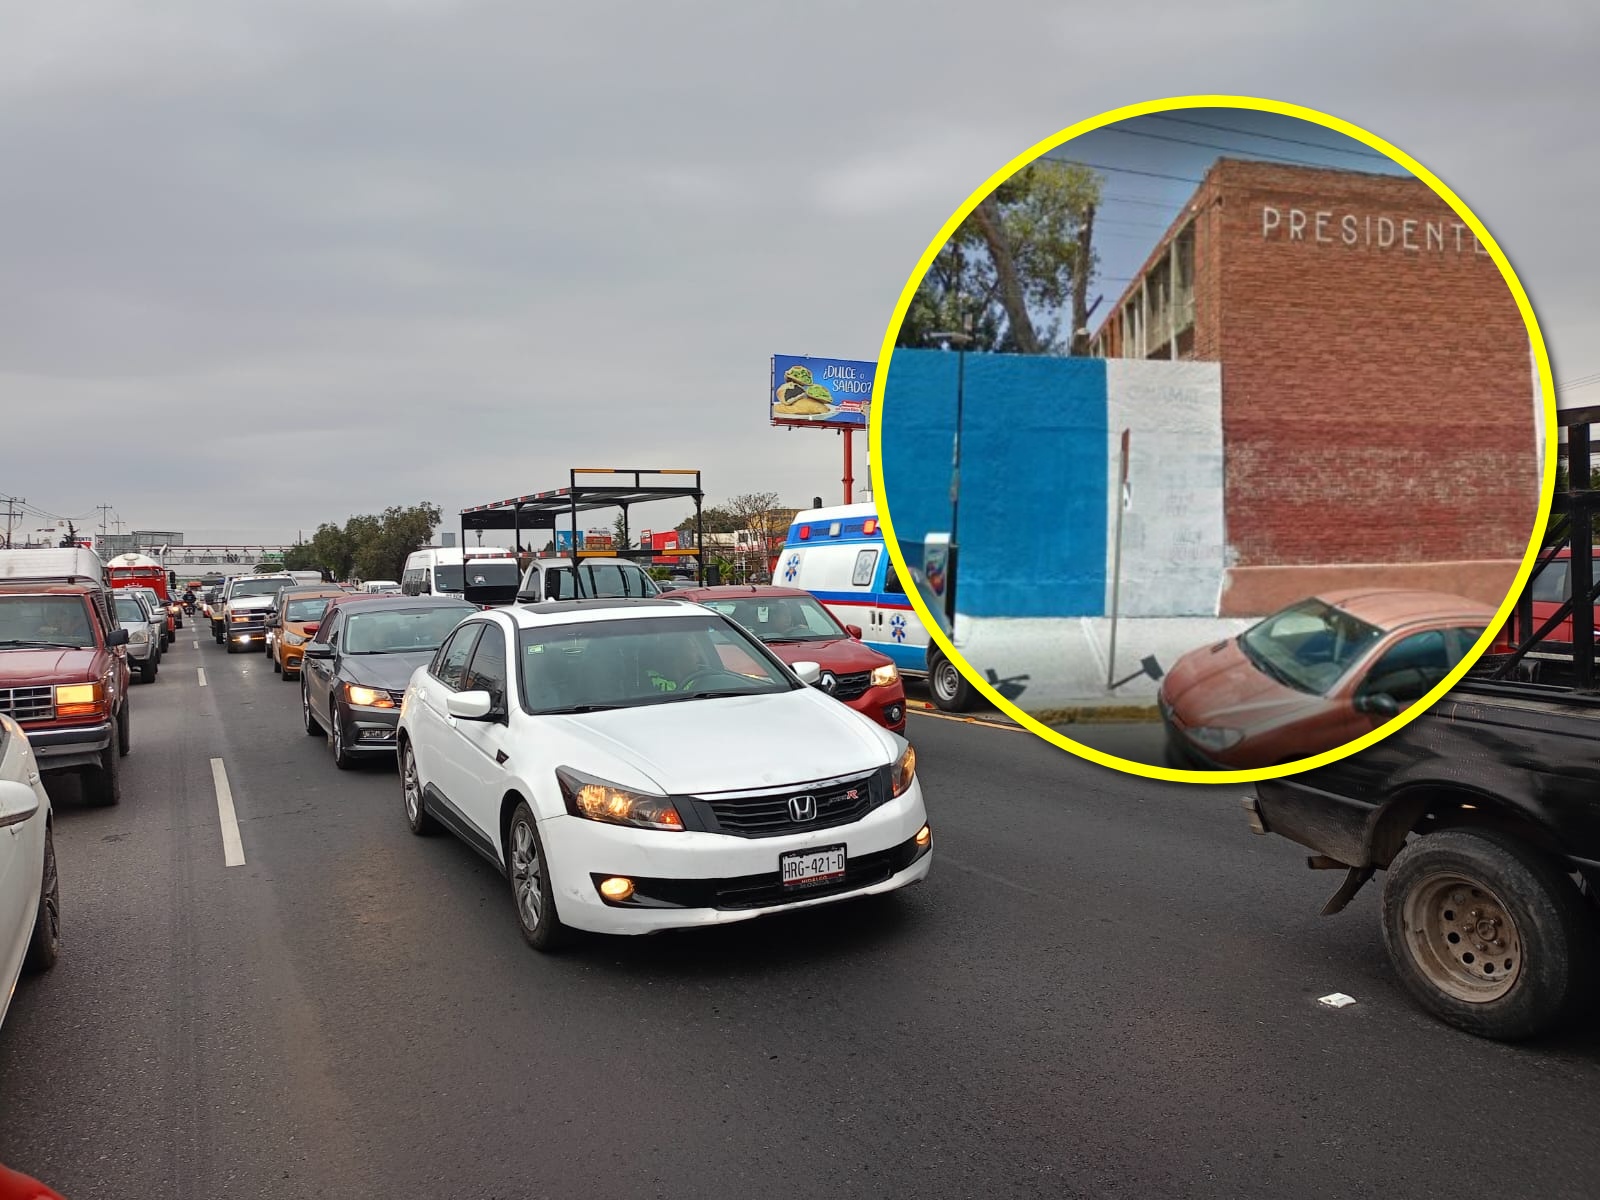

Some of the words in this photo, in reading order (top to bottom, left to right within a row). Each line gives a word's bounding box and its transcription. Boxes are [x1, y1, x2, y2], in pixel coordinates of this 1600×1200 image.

[823, 365, 856, 380] ¿DULCE
[832, 379, 871, 393] SALADO?
[784, 854, 844, 879] HRG-421-D
